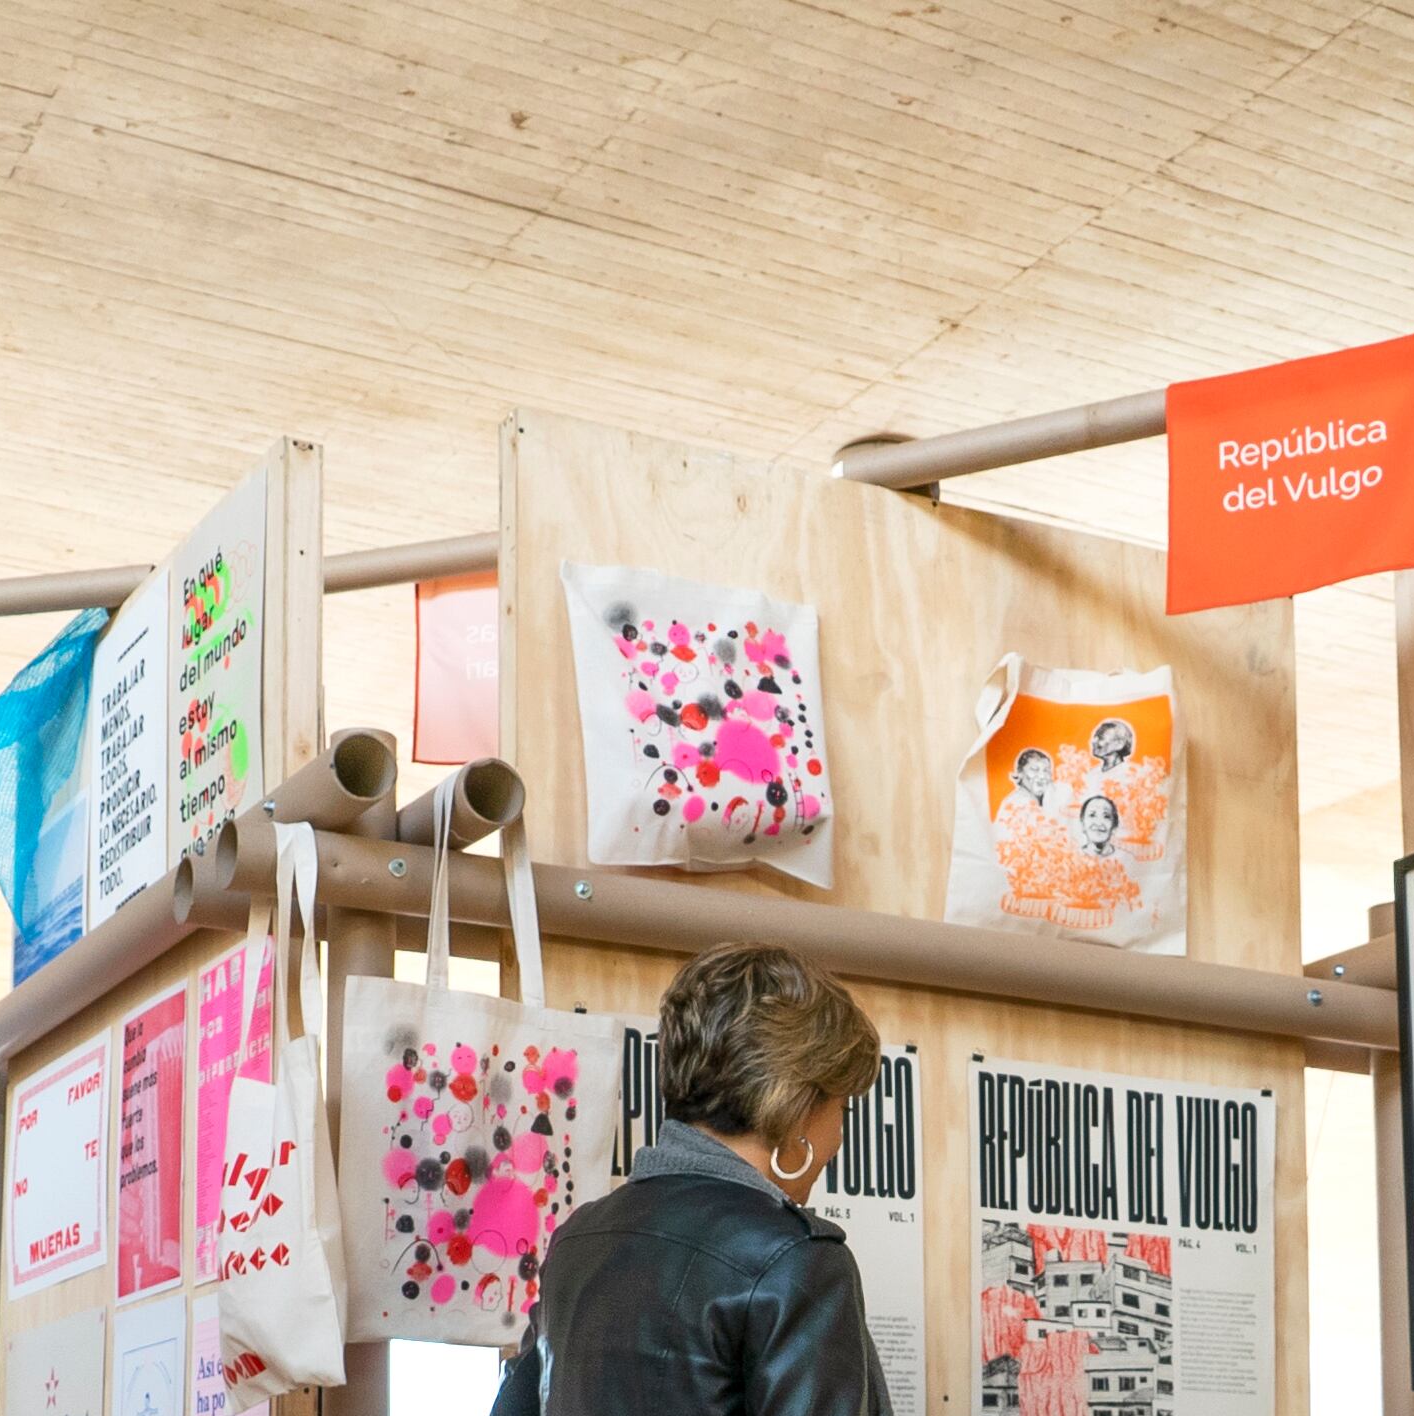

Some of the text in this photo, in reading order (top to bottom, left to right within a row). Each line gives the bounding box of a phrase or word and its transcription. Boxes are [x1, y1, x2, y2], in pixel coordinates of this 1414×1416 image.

[1218, 420, 1387, 470] República
[1222, 466, 1383, 512] del Vulgo
[183, 545, 223, 604] En qué
[182, 605, 214, 649] lugar
[179, 615, 246, 692] del mundo
[101, 659, 145, 713] TRABAJAR
[179, 691, 215, 735] estoy
[100, 715, 144, 770] TRABAJAR
[179, 720, 237, 780] al mismo
[99, 769, 141, 822] PRODUCIR
[180, 774, 225, 823] tiempo
[99, 815, 152, 875] REDISTRIBUIR
[67, 1072, 101, 1106] FAVOR
[19, 1110, 38, 1135] POR
[826, 1055, 916, 1199] ULGO
[84, 1140, 98, 1161] TE
[979, 1071, 1258, 1234] REPÚBLICA DEL VULGO
[14, 1178, 28, 1198] NO
[889, 1211, 908, 1222] VOL.
[29, 1223, 80, 1265] MUERAS
[197, 1355, 215, 1381] Así
[196, 1391, 210, 1413] ha
